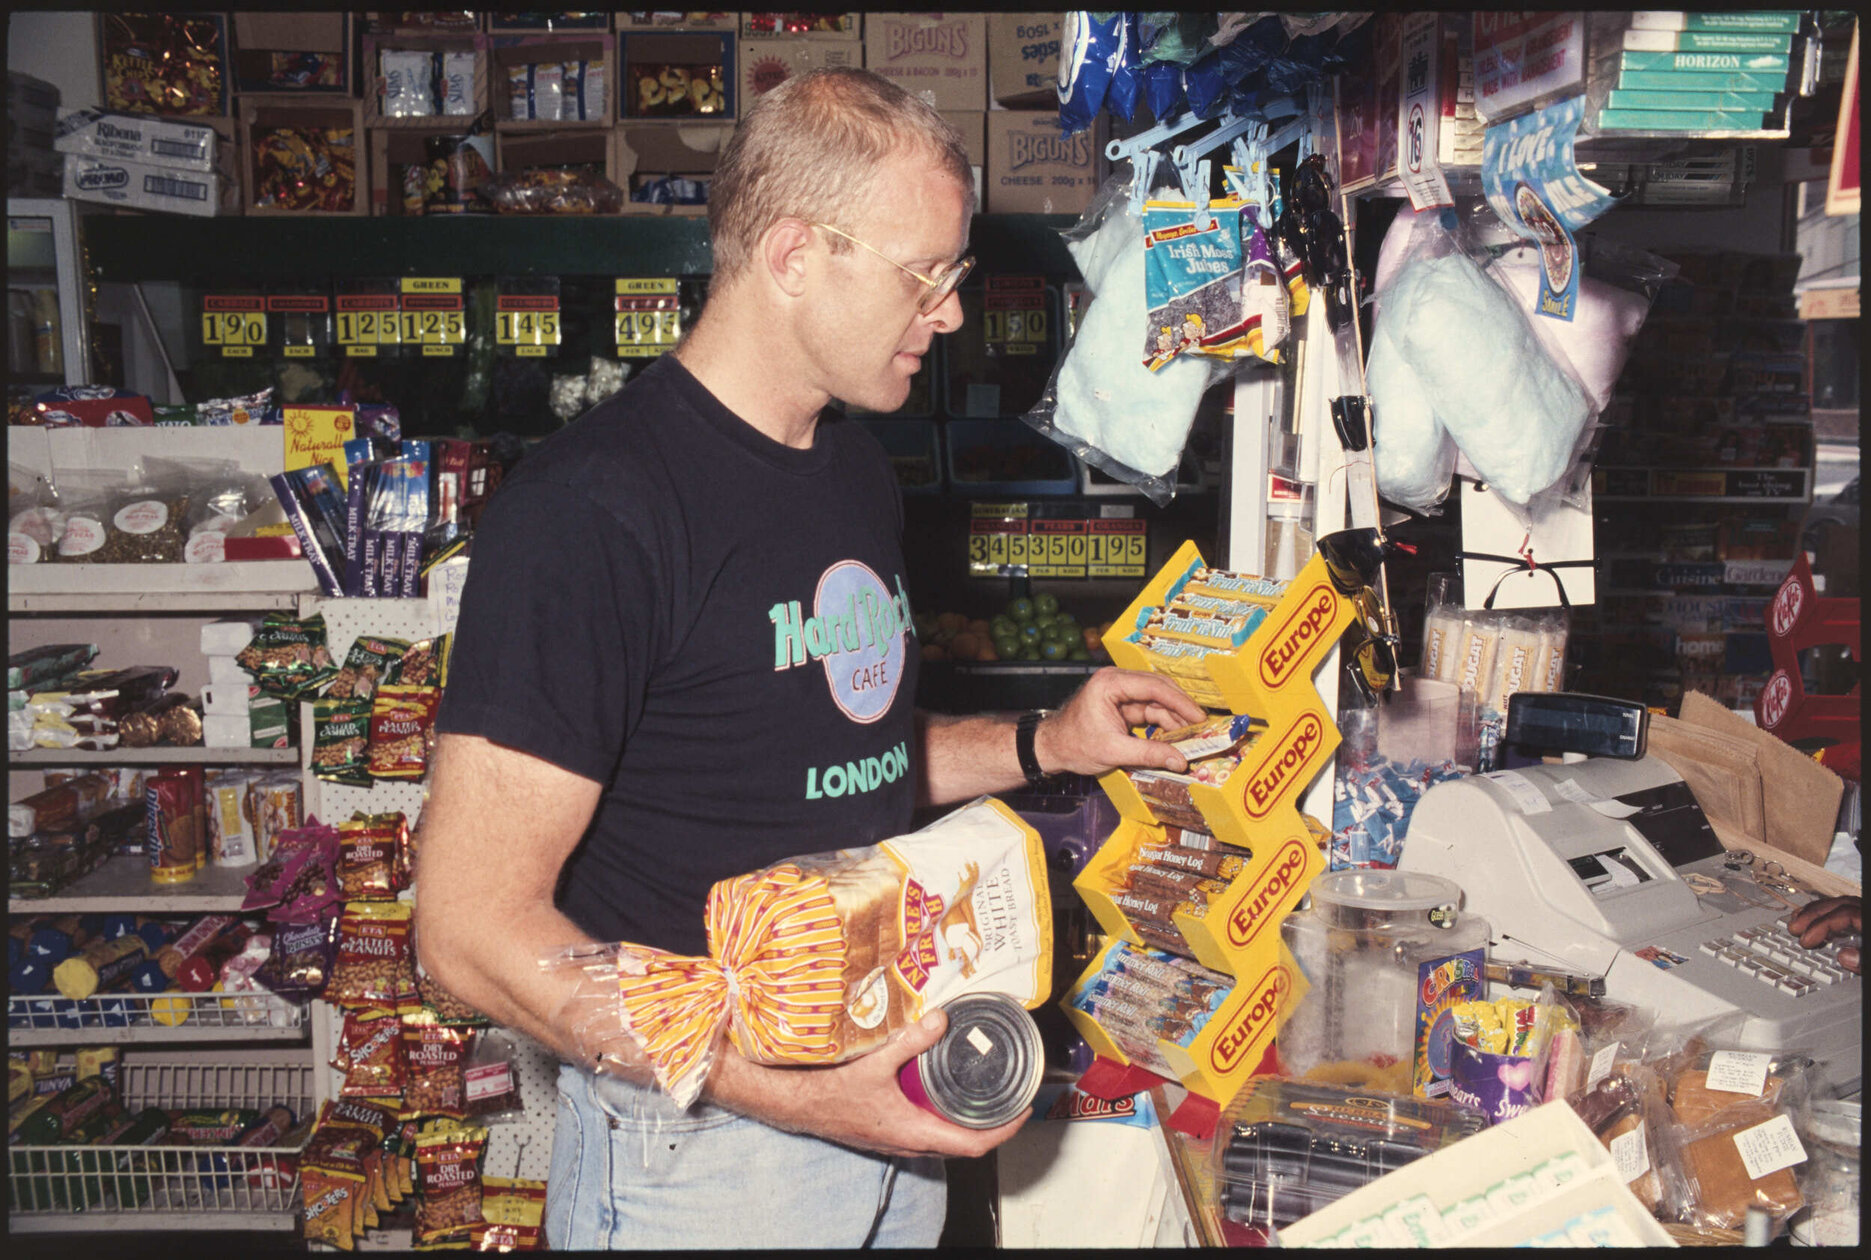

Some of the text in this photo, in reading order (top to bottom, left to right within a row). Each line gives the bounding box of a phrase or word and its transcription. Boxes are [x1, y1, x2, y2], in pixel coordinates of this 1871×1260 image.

[884, 21, 969, 62] BIGUNS
[1016, 24, 1050, 40] 150g
[112, 53, 155, 70] KETTLE
[1675, 55, 1741, 69] HORIZON
[120, 67, 154, 80] CHIPS
[96, 121, 142, 142] Ribena
[1005, 129, 1092, 172] BIGUNS
[1000, 175, 1044, 187] CHEESE
[1052, 175, 1075, 189] 200g
[1167, 241, 1235, 260] Irish Moss
[1185, 257, 1231, 276] Jubes
[412, 280, 450, 290] GREEN
[628, 282, 665, 290] GREEN
[1541, 289, 1571, 318] SMILE
[204, 314, 263, 343] 190
[339, 313, 397, 342] 125
[404, 313, 461, 341] 125
[500, 314, 557, 340] 145
[290, 434, 346, 454] Naturall
[288, 513, 320, 564] MILK TRAY
[347, 507, 358, 562] MILK TRAY
[970, 536, 1025, 562] 345
[1031, 536, 1085, 556] 350
[1090, 536, 1144, 562] 195
[364, 539, 375, 593] MILK TRAY
[383, 539, 395, 593] MILK TRAY
[403, 540, 417, 594] MILK TRAY
[1206, 573, 1240, 591] Fruit
[1656, 568, 1723, 586] Cuisine
[768, 574, 917, 672] Hard Rock
[1160, 614, 1198, 634] Fruit
[1264, 592, 1334, 680] Europe
[1675, 635, 1725, 655] home
[1150, 640, 1187, 658] Fruit
[852, 661, 889, 692] CAFE
[379, 725, 422, 735] PEANUTS
[384, 719, 418, 730] SALTED
[805, 741, 909, 800] LONDON
[1249, 721, 1318, 809] Europe
[284, 791, 297, 828] Digest
[146, 788, 163, 868] Digestive
[346, 850, 384, 860] ROASTED
[1139, 846, 1204, 872] Nougat Honey Log
[1144, 865, 1185, 883] Honey Log
[1231, 848, 1303, 937] Europe
[986, 876, 1006, 953] WHITE
[1001, 867, 1024, 953] TOAST BREAD
[1121, 894, 1159, 915] Honey Log
[974, 884, 991, 953] ORIGINAL
[283, 926, 322, 945] Chocolate
[361, 927, 382, 936] ETA
[899, 885, 925, 987] NARE'S
[918, 898, 944, 966] FRH
[347, 944, 396, 957] PEANUTS
[348, 937, 394, 949] SALTED
[1116, 952, 1166, 979] ummer Roll
[1129, 981, 1150, 998] Roll
[1422, 958, 1480, 1006] CRYSTAL
[1118, 1001, 1138, 1018] Roll
[1215, 974, 1286, 1064] Europe
[350, 1026, 399, 1064] SHOOTERS
[409, 1050, 458, 1061] ROASTED
[423, 1044, 443, 1054] DRY
[1448, 1078, 1482, 1108] hearts
[1494, 1098, 1528, 1120] Swe
[440, 1152, 461, 1162] ETA
[426, 1170, 475, 1184] ROASTED
[440, 1163, 461, 1175] DRY
[437, 1179, 465, 1189] PEANUTS
[305, 1187, 349, 1221] SHOOTERS
[489, 1234, 515, 1246] ETA
